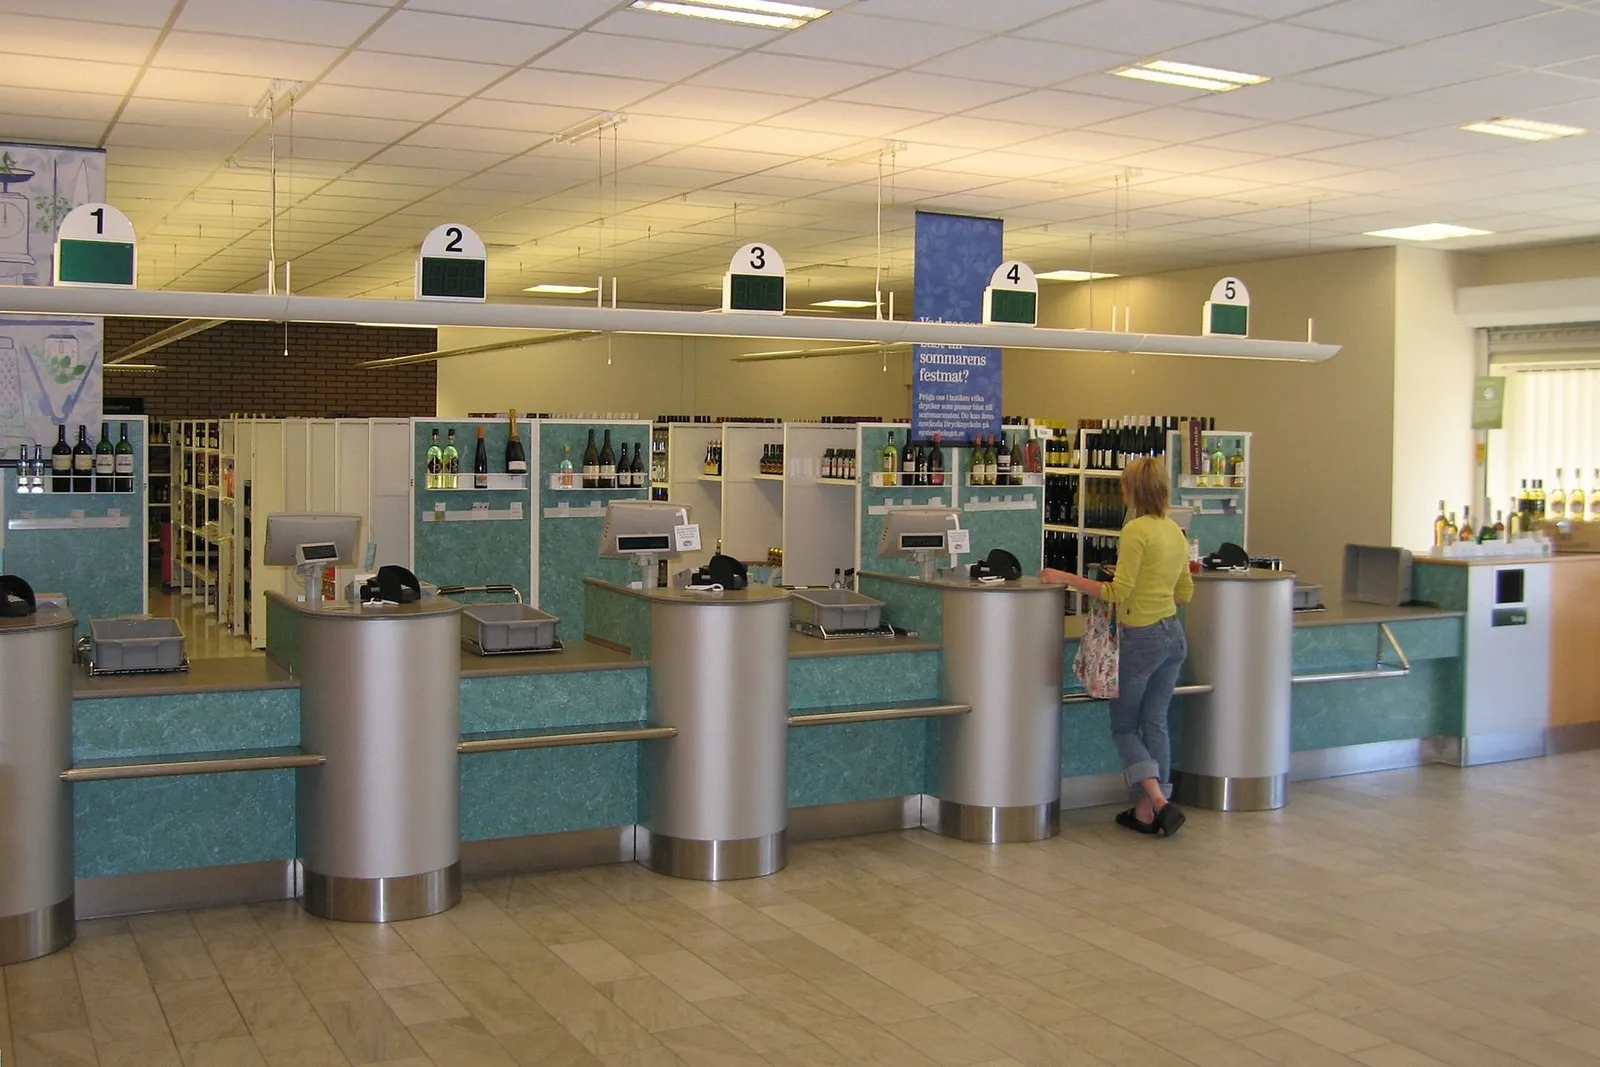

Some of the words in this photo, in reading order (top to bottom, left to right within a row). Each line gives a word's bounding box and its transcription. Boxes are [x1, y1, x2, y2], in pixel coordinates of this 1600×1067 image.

[90, 208, 104, 234] 1
[446, 227, 463, 252] 2
[751, 246, 766, 269] 3
[1006, 264, 1021, 285] 4
[1225, 281, 1236, 300] 5
[919, 352, 987, 366] sommarens
[919, 368, 969, 383] festmat?
